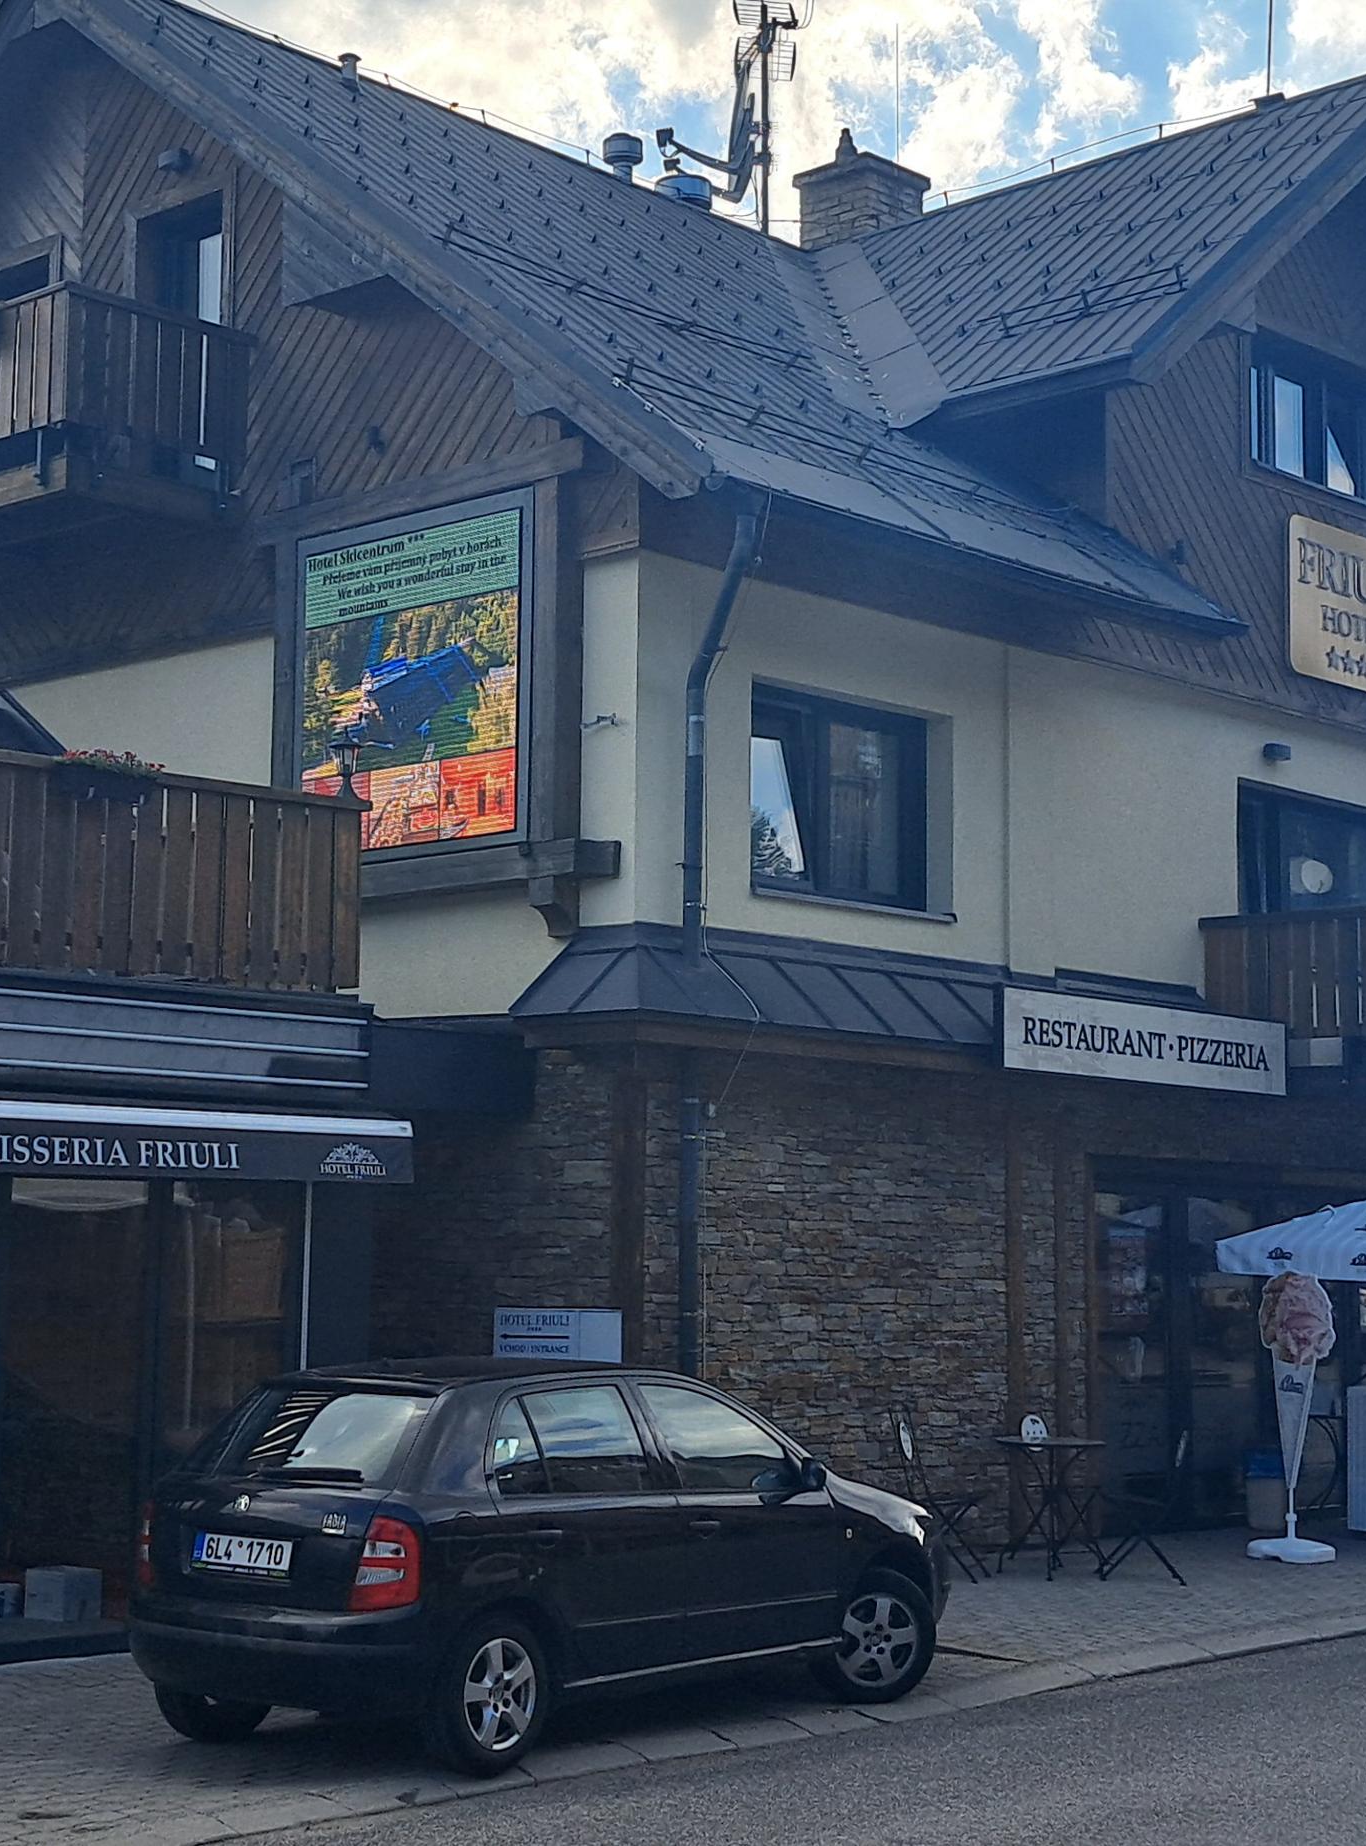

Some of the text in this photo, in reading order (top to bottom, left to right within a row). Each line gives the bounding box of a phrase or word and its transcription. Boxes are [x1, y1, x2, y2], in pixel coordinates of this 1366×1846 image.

[308, 541, 405, 572] Hotel Skicentrum
[376, 580, 394, 594] you
[403, 562, 455, 587] wonderful
[1021, 1016, 1270, 1072] RESTAURANT PIZZERIA
[137, 1139, 241, 1170] FRIULI
[319, 1163, 387, 1178] HOTEL FRIULI
[499, 1313, 570, 1327] HOTEL FRIULI
[322, 1512, 347, 1529] FABIA
[205, 1536, 285, 1566] 6L4 1710
